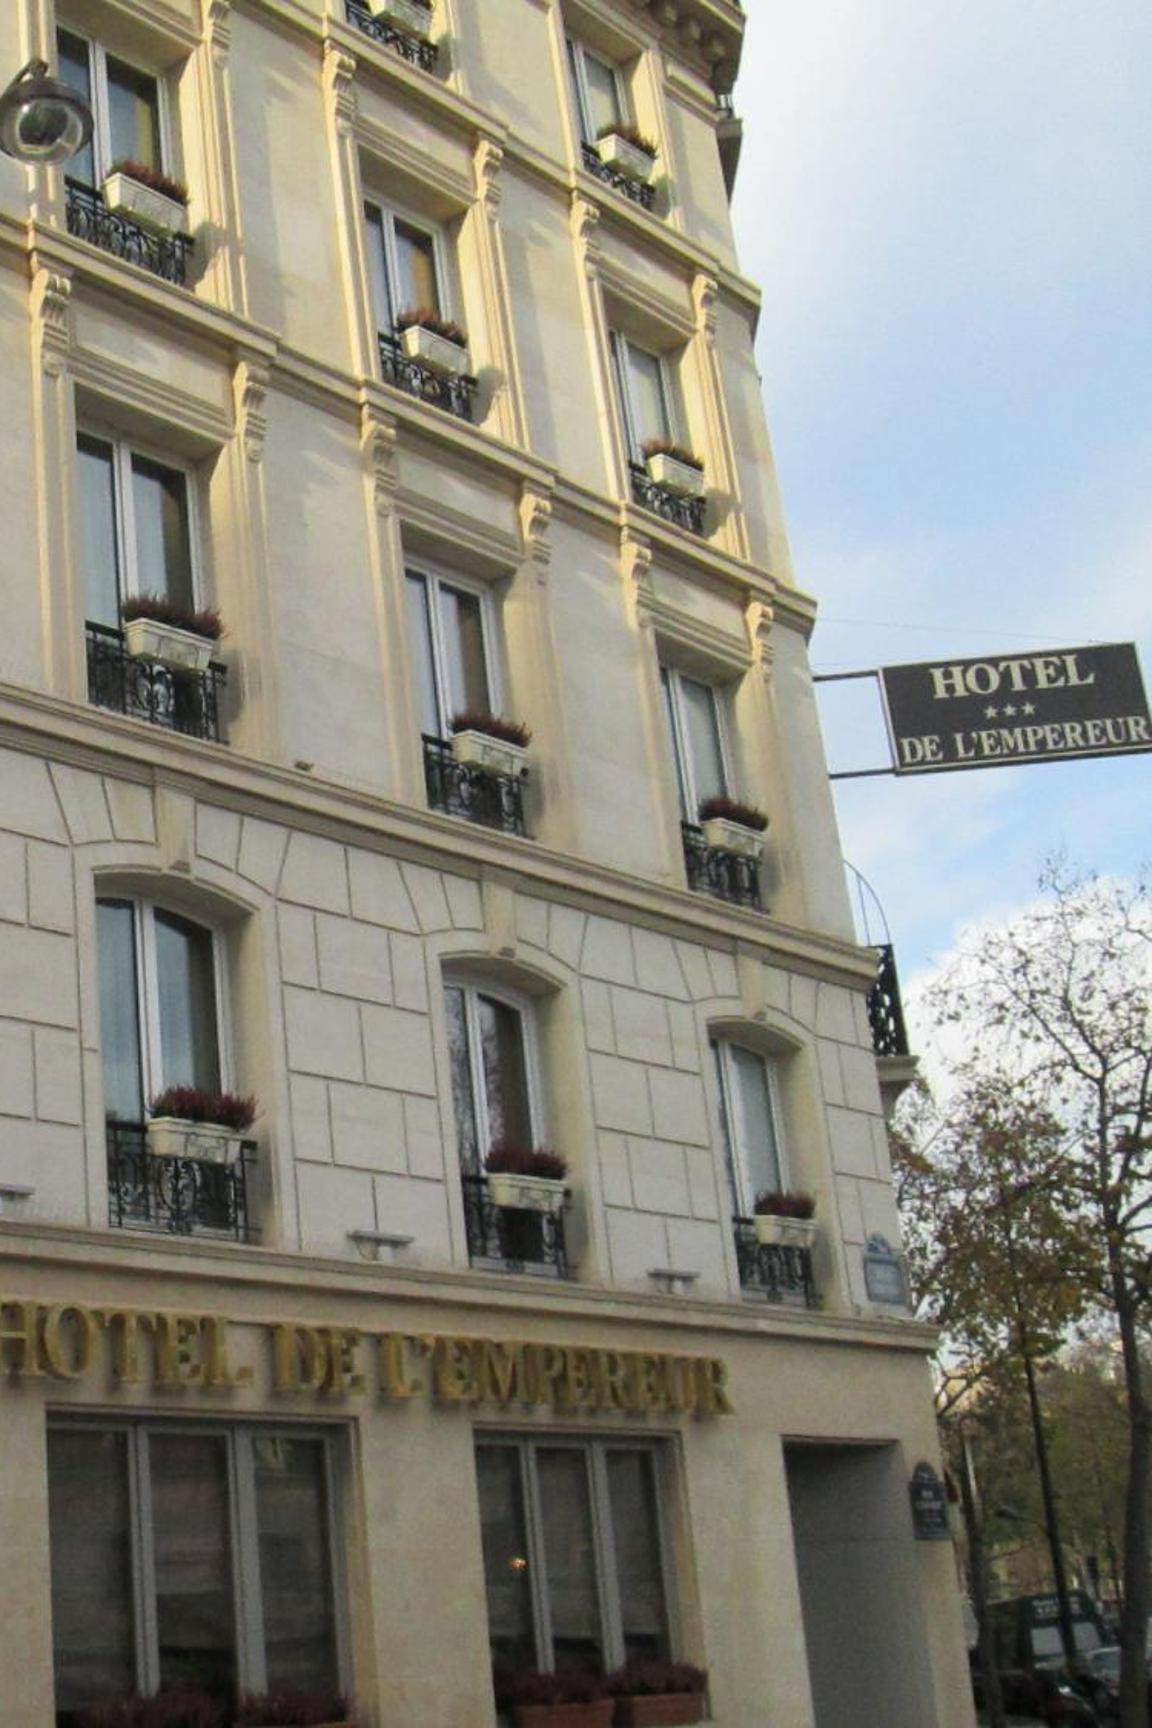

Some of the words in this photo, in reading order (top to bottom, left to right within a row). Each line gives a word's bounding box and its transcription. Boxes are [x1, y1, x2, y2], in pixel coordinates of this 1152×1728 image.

[929, 655, 1095, 699] HOTEL
[900, 735, 944, 763] DE
[955, 715, 1151, 760] L'EMPEREUR
[274, 1322, 366, 1395] DE
